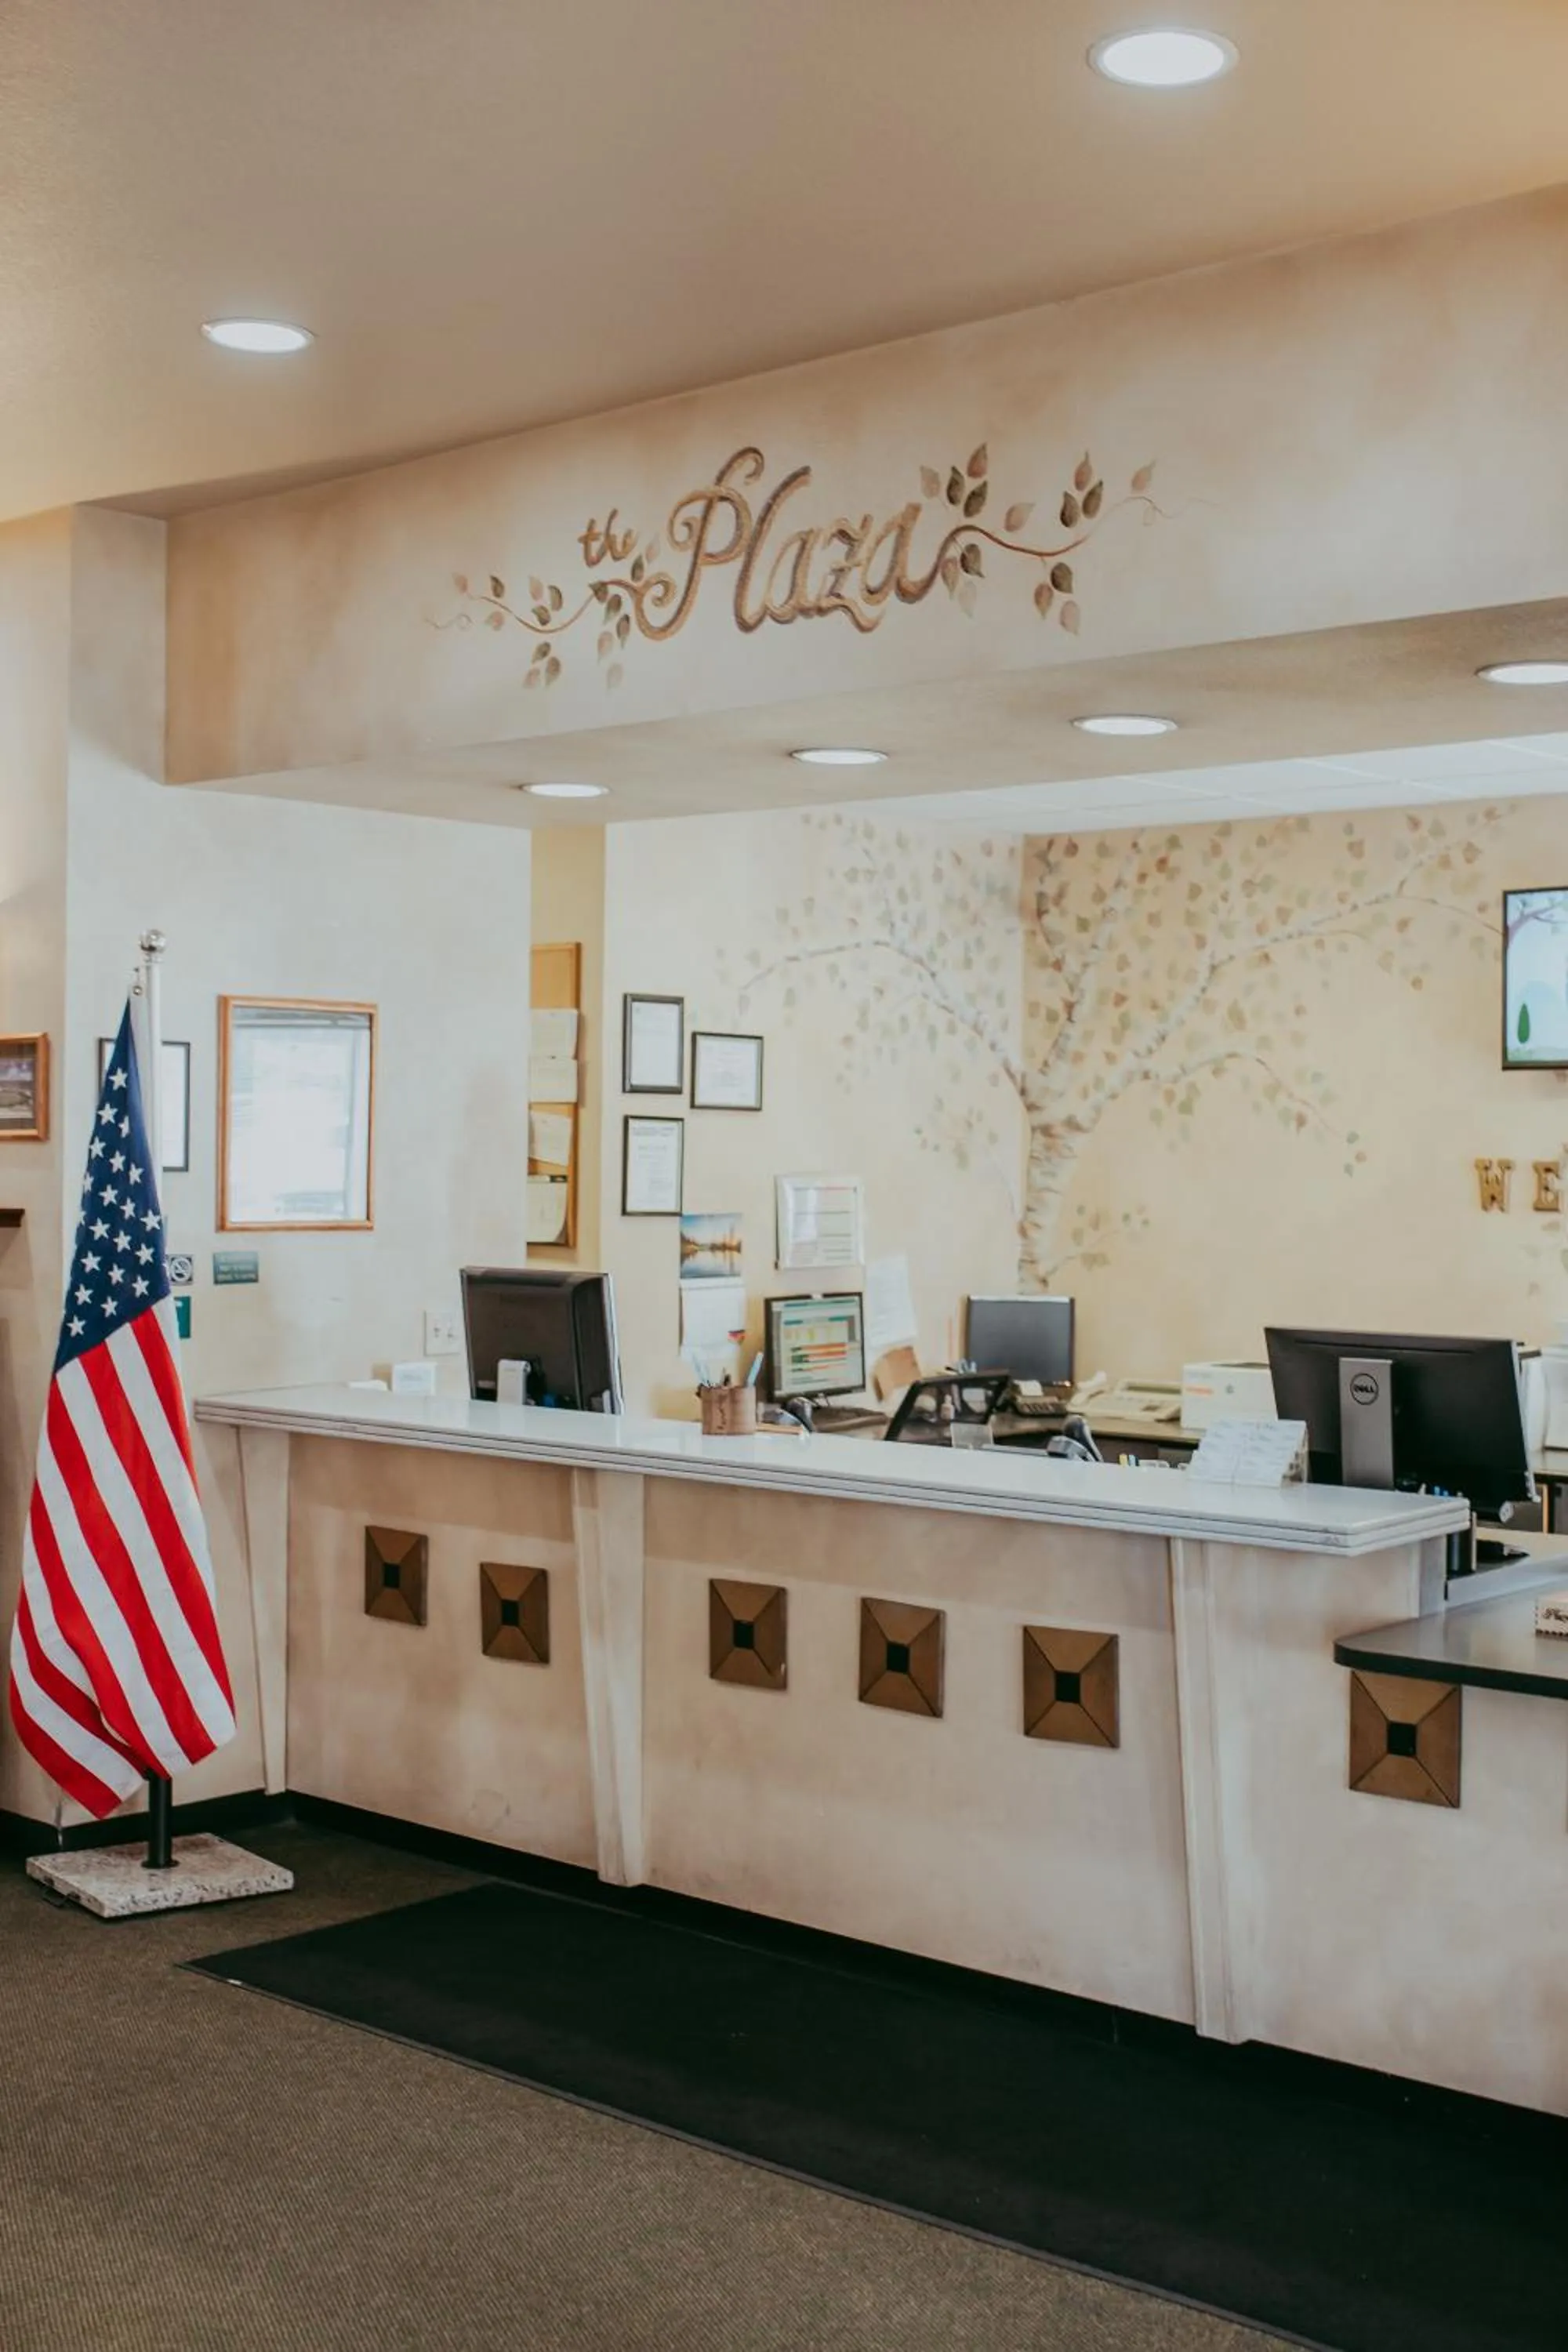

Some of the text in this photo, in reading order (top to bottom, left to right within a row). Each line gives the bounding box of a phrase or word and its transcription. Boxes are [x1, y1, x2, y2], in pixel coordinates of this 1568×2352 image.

[577, 446, 942, 641] the Plaza
[1353, 1384, 1374, 1392] DELL
